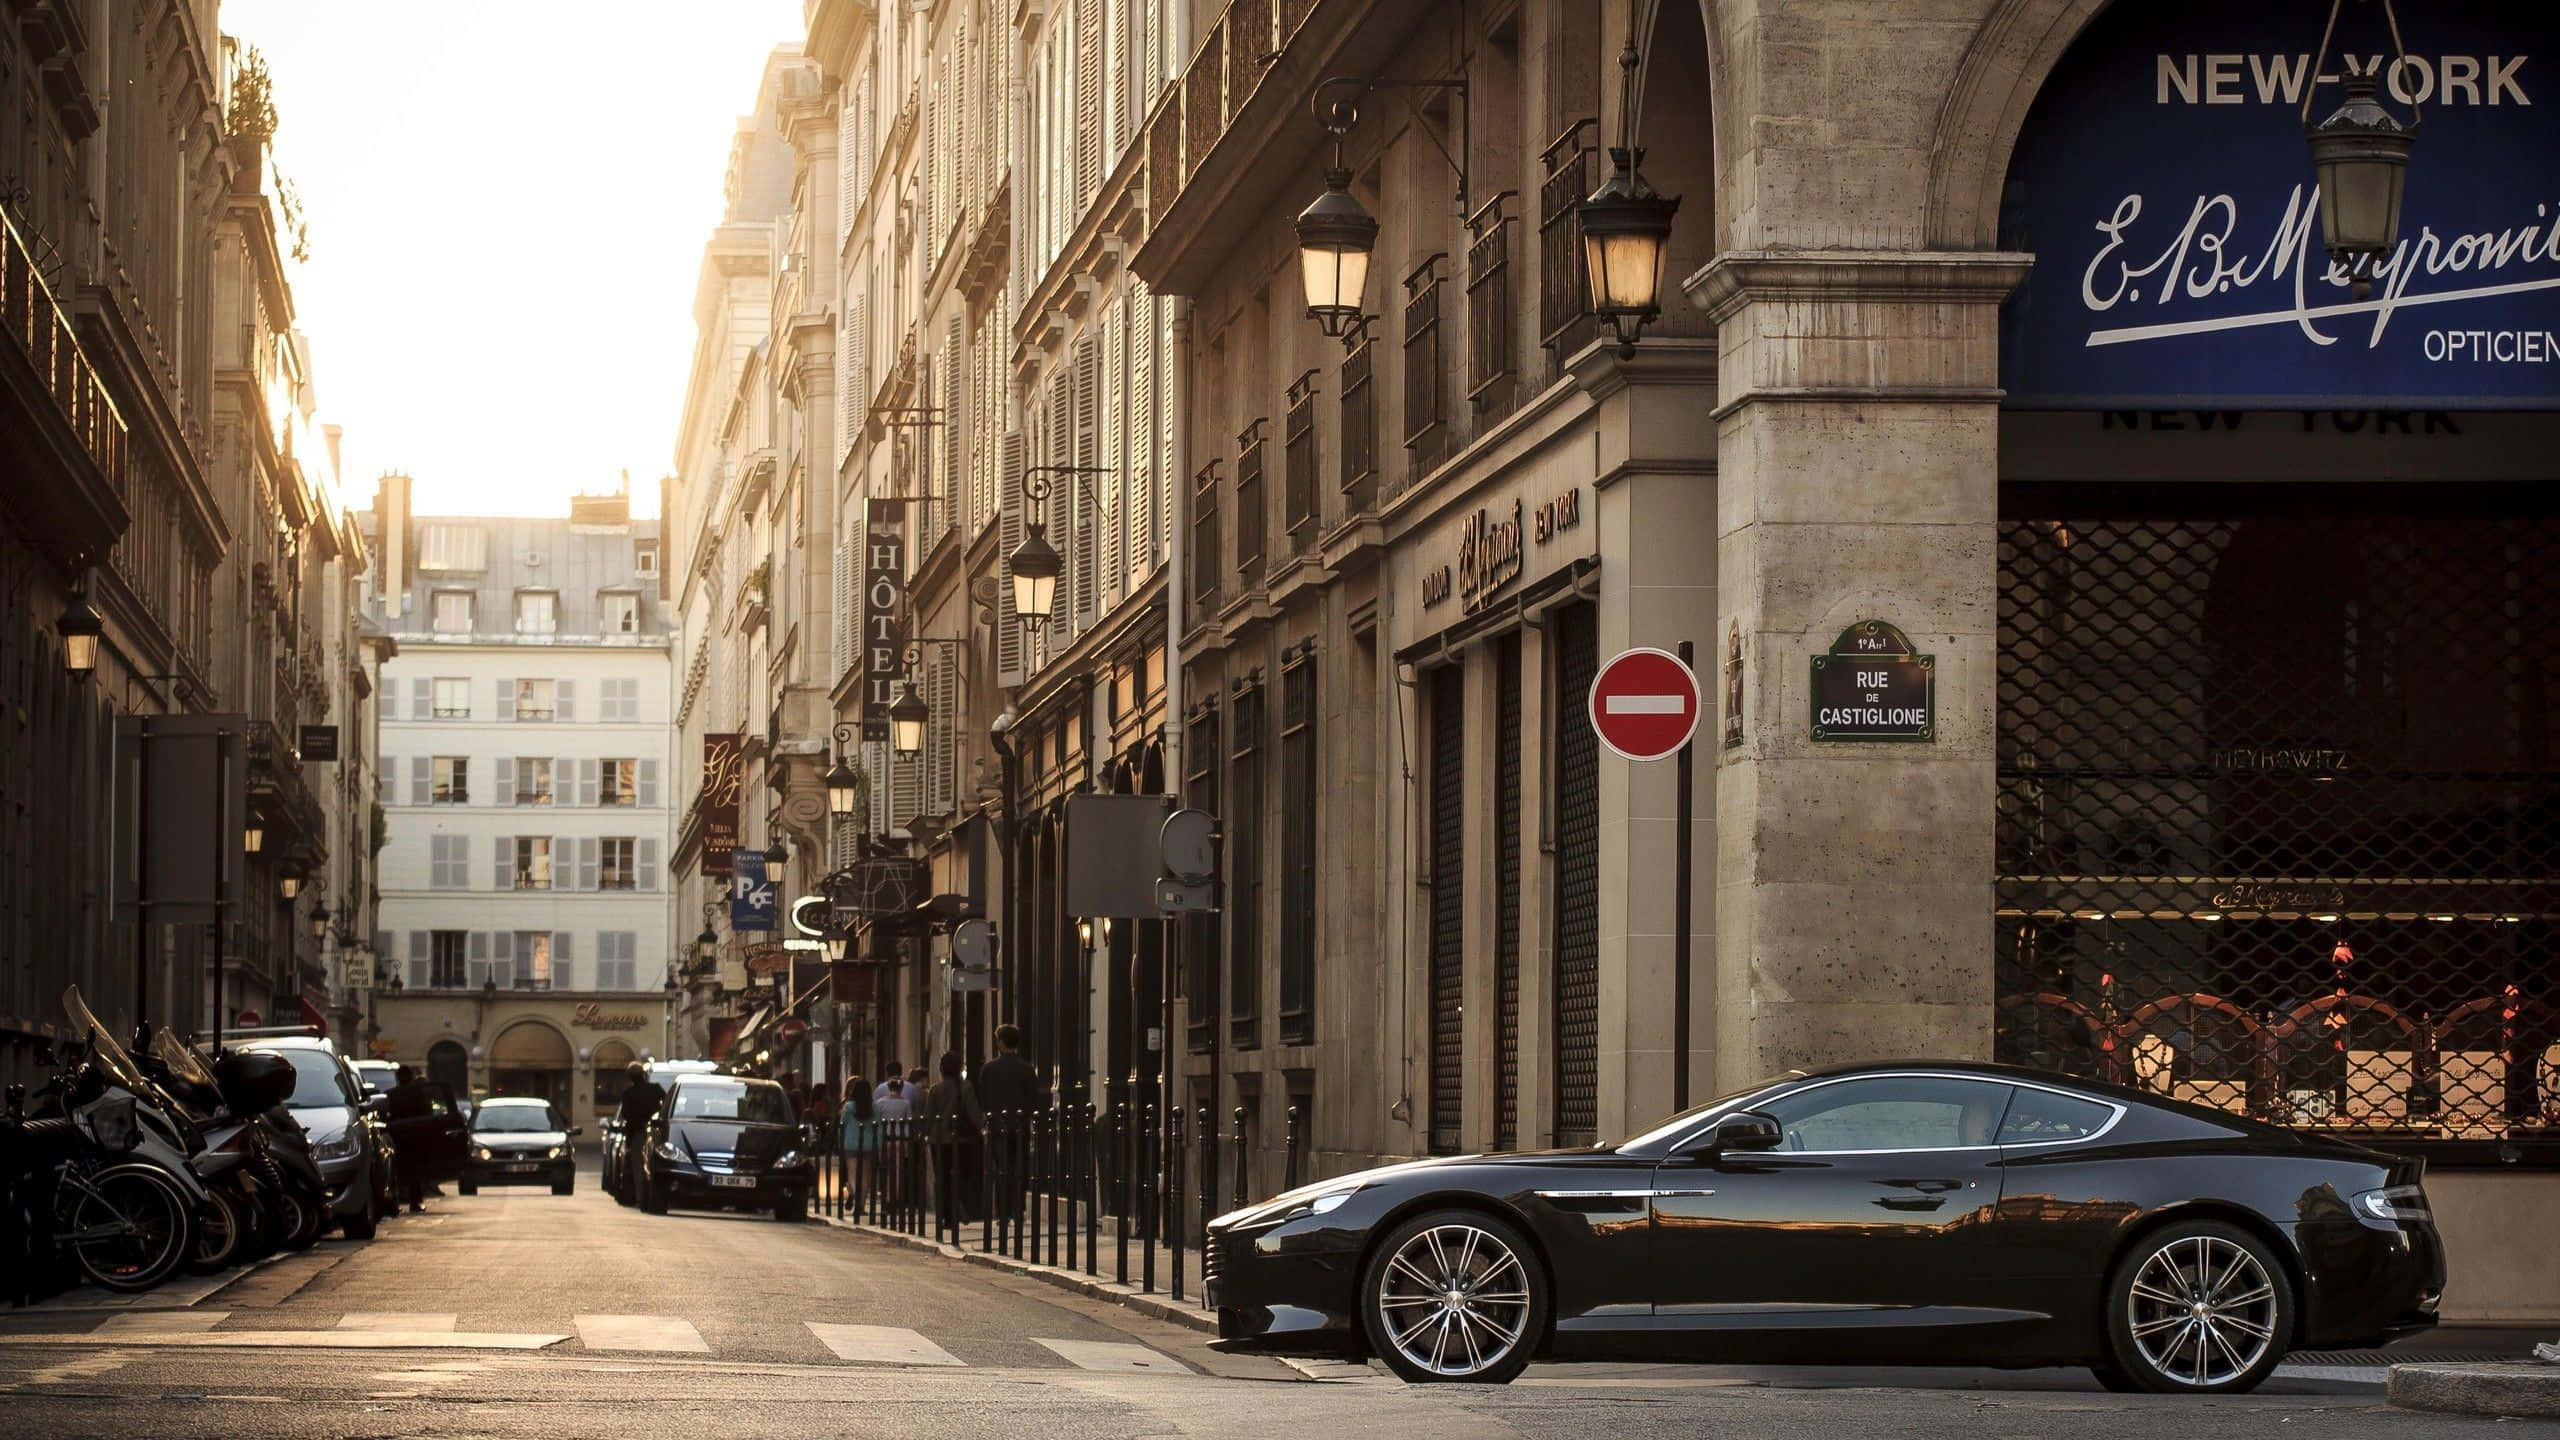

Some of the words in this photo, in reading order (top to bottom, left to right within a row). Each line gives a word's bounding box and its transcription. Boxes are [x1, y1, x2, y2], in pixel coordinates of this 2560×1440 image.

[1857, 671, 1889, 689] RUE
[1866, 693, 1879, 703] DE
[1820, 707, 1926, 726] CASTIGLIONE
